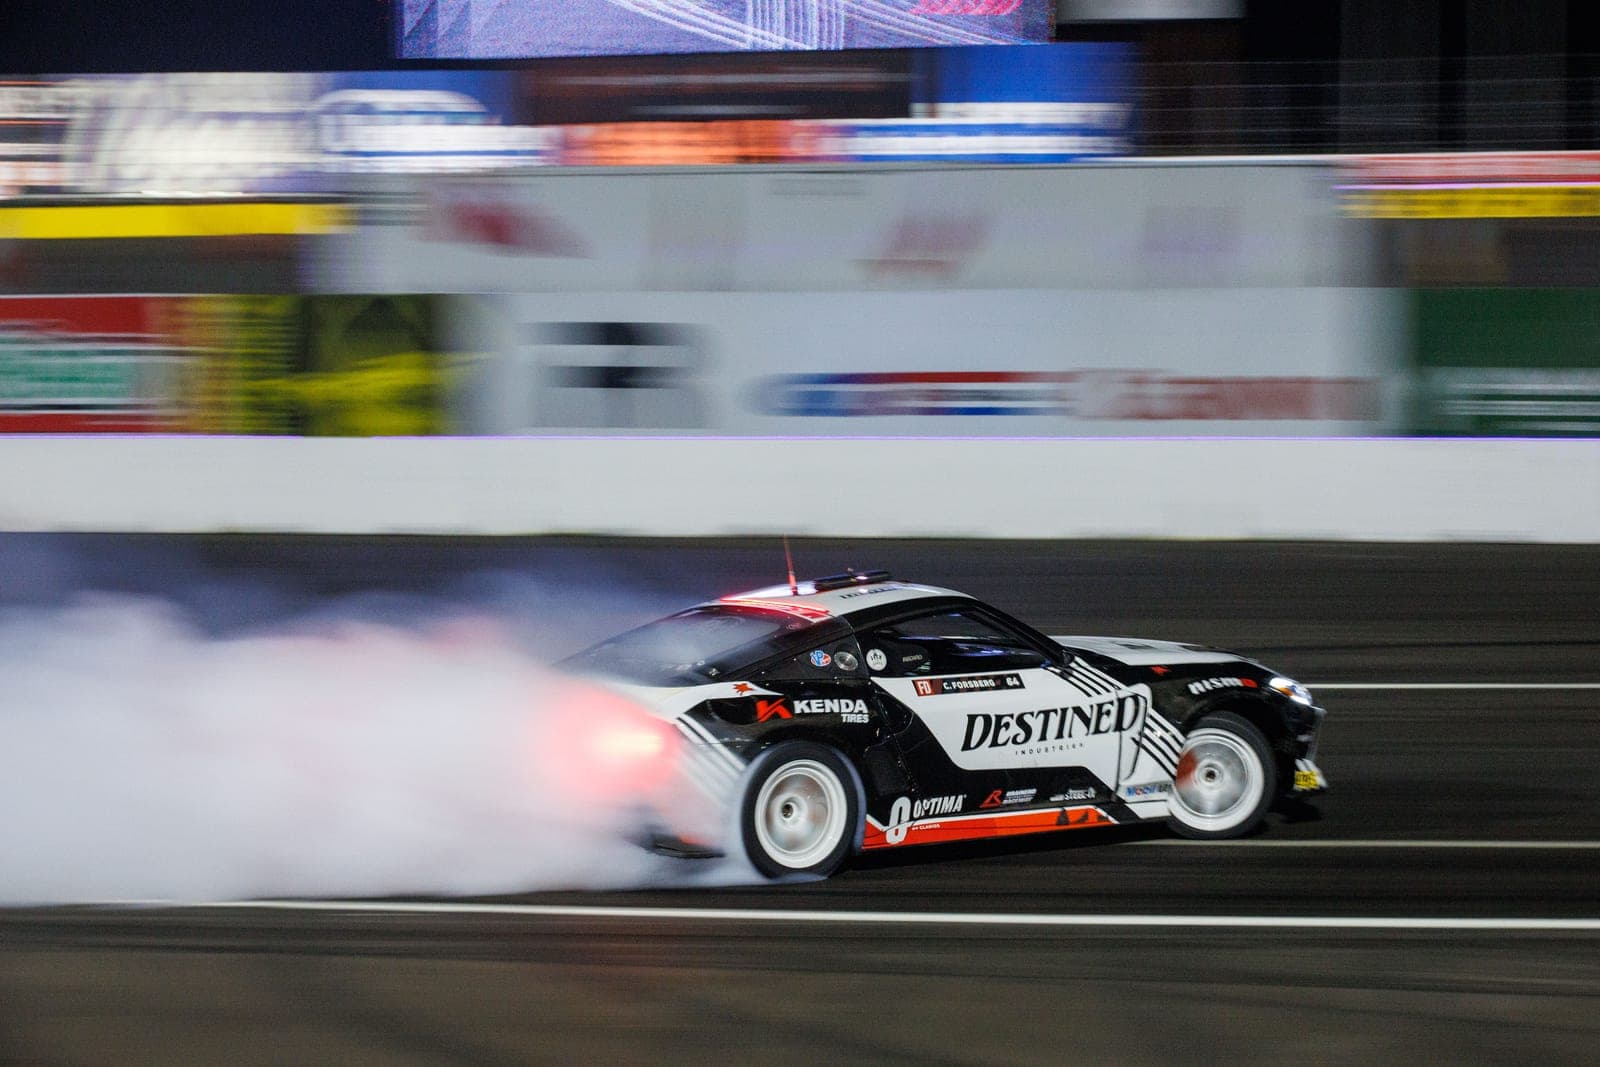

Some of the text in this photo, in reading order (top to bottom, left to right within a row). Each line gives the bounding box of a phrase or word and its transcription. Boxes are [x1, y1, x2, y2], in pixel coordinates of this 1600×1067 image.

[917, 680, 932, 694] FD
[953, 679, 995, 689] FORSBERG
[1005, 677, 1020, 687] 64
[793, 699, 869, 714] KENDA
[841, 714, 869, 723] TIRES
[961, 694, 1141, 752] DESTINED
[1015, 743, 1084, 755] INDUSTRIES
[913, 795, 964, 818] OPTIMA
